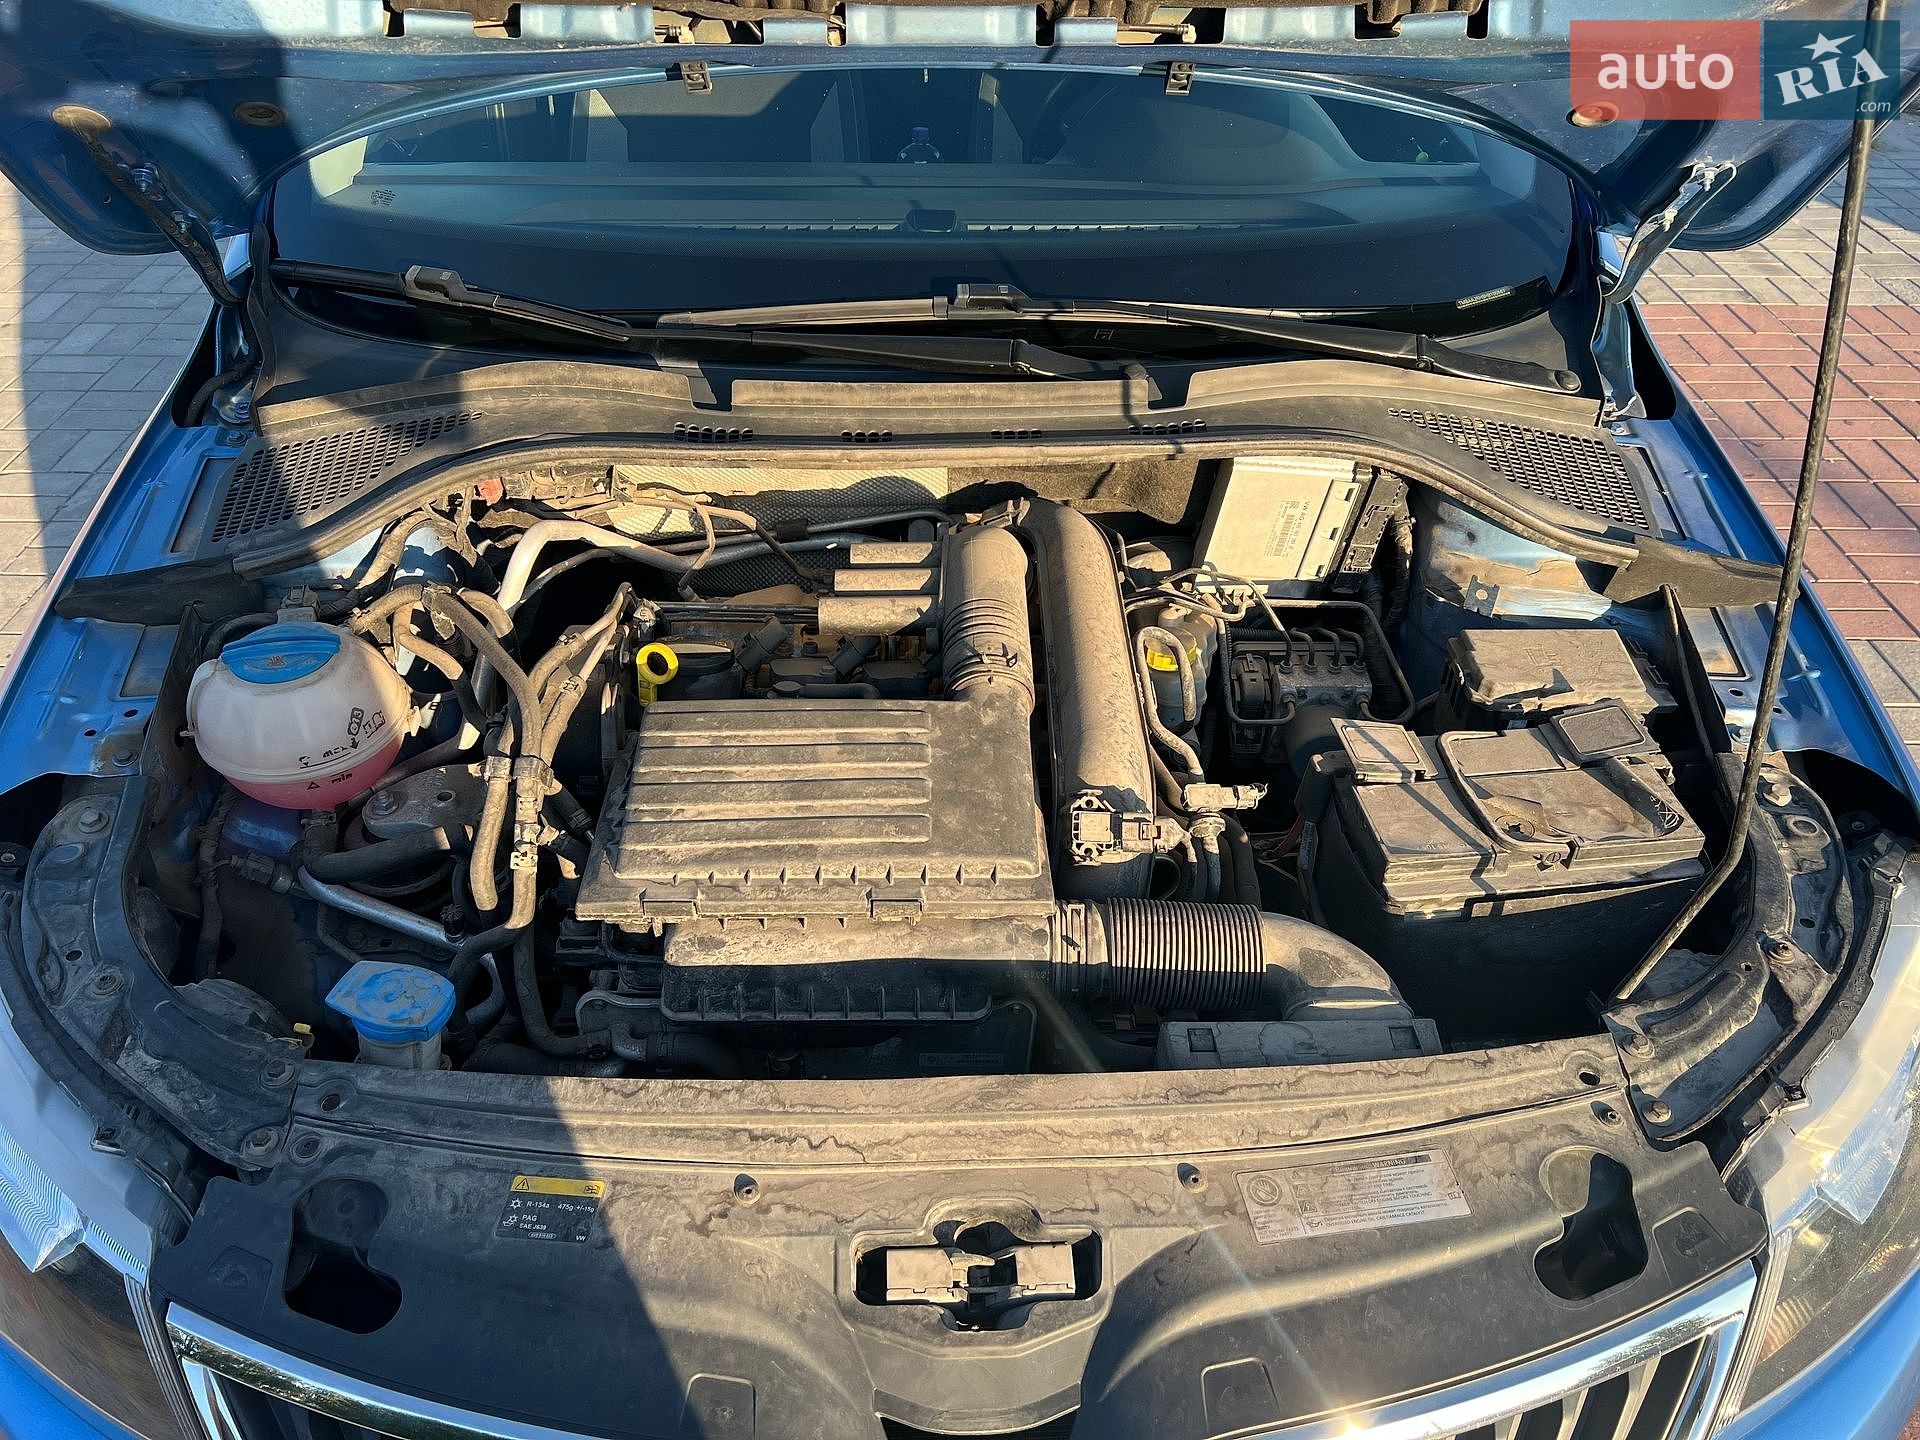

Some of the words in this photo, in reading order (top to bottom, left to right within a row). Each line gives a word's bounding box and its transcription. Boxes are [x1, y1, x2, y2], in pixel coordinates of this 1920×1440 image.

[331, 773, 352, 784] min
[526, 1200, 550, 1208] R-134a
[521, 1214, 537, 1222] PAG
